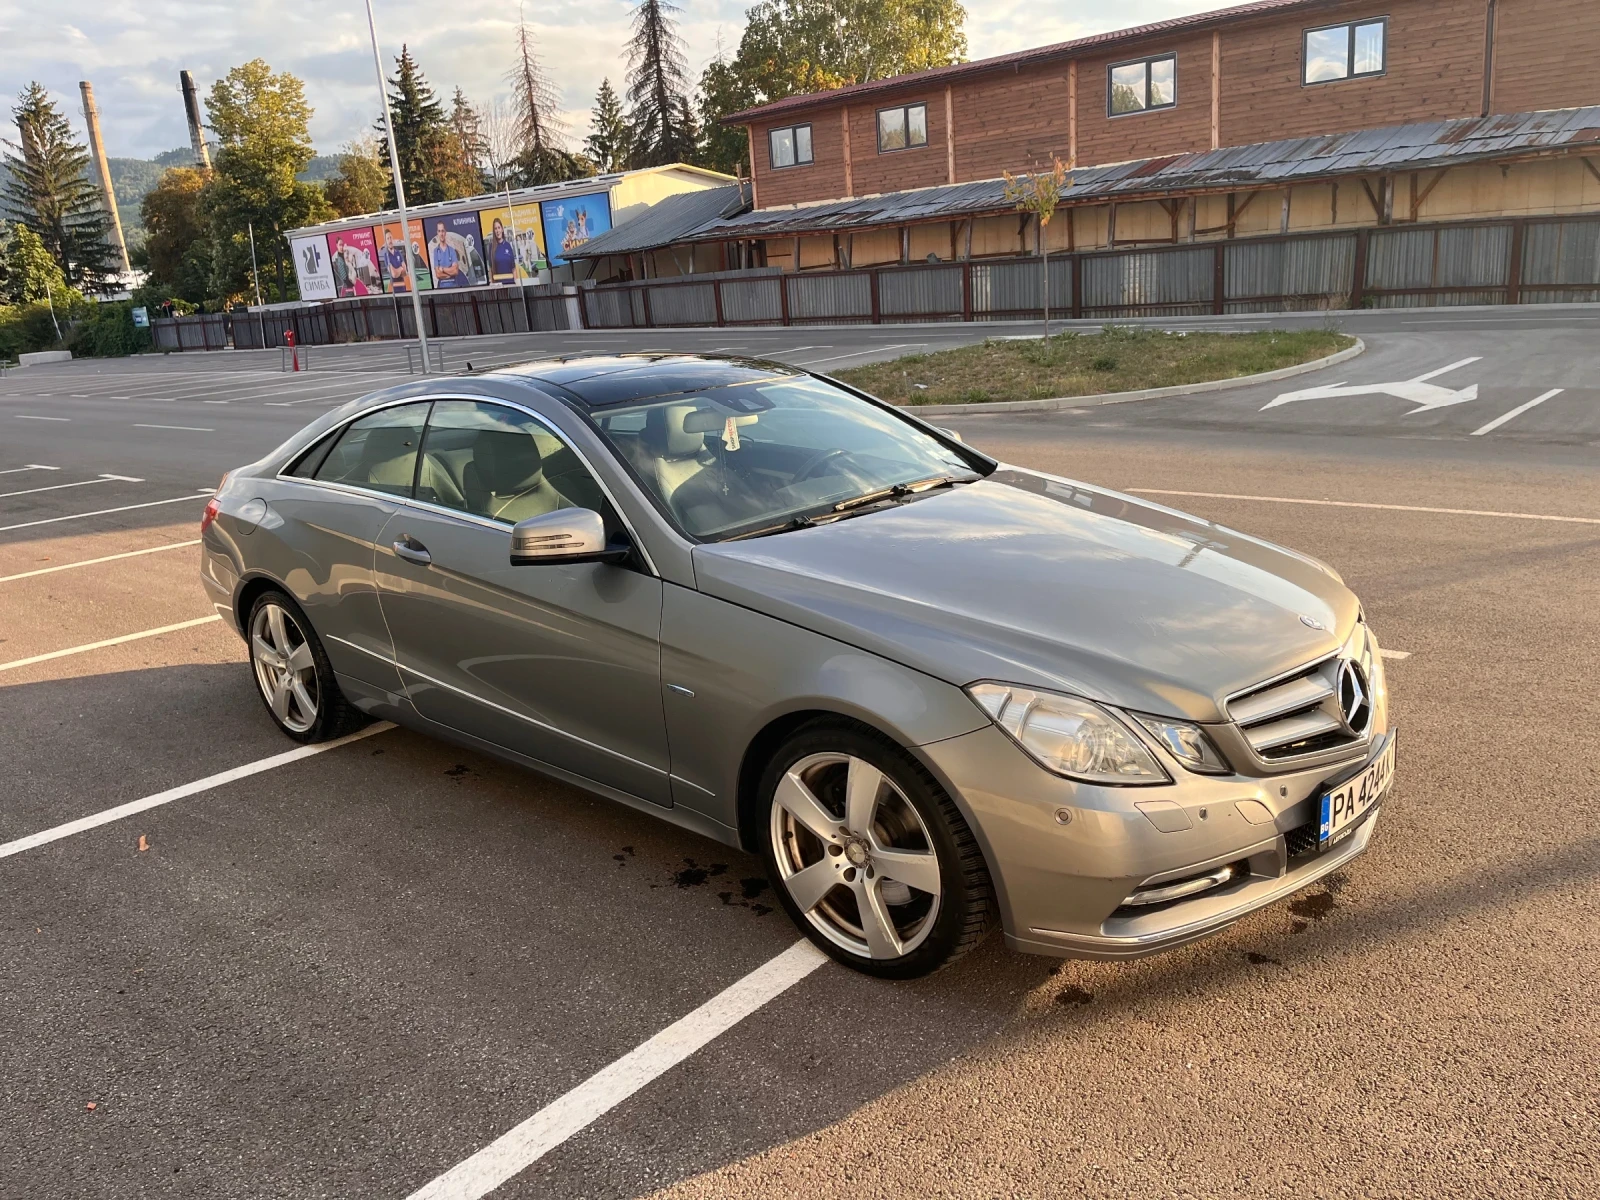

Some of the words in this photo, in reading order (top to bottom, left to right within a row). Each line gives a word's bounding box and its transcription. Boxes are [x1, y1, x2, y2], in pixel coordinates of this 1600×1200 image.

[453, 217, 476, 226] КЛИНИКА
[304, 280, 330, 291] СИМБА
[1332, 786, 1355, 828] PA
[1358, 755, 1387, 807] 4244
[1320, 822, 1329, 835] BG
